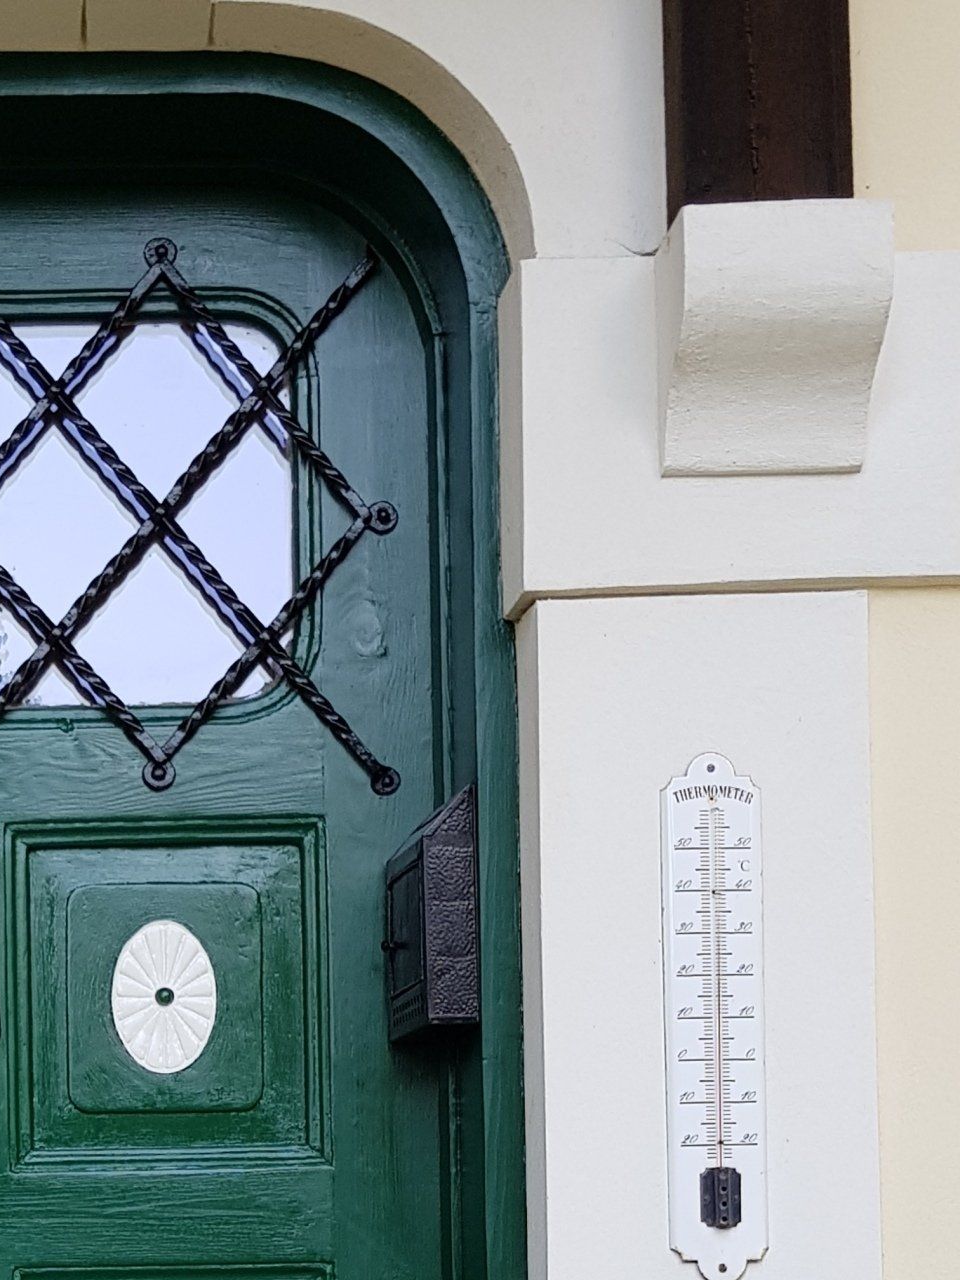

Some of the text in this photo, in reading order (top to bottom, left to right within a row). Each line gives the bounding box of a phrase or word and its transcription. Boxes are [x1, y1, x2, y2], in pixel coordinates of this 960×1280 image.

[672, 784, 754, 805] THERMOMETER
[674, 837, 692, 847] 50
[733, 837, 752, 847] 50
[675, 880, 692, 889] 40
[735, 879, 752, 889] 40
[675, 922, 694, 932] 30
[734, 921, 753, 931] 30
[677, 964, 694, 974] 20
[736, 964, 753, 973] 20
[677, 1007, 693, 1016] 10
[739, 1006, 755, 1016] 10
[677, 1049, 687, 1058] 0
[745, 1048, 755, 1058] 0
[679, 1091, 695, 1101] 10
[741, 1091, 757, 1100] 10
[681, 1134, 699, 1144] 20
[740, 1133, 758, 1143] 20
